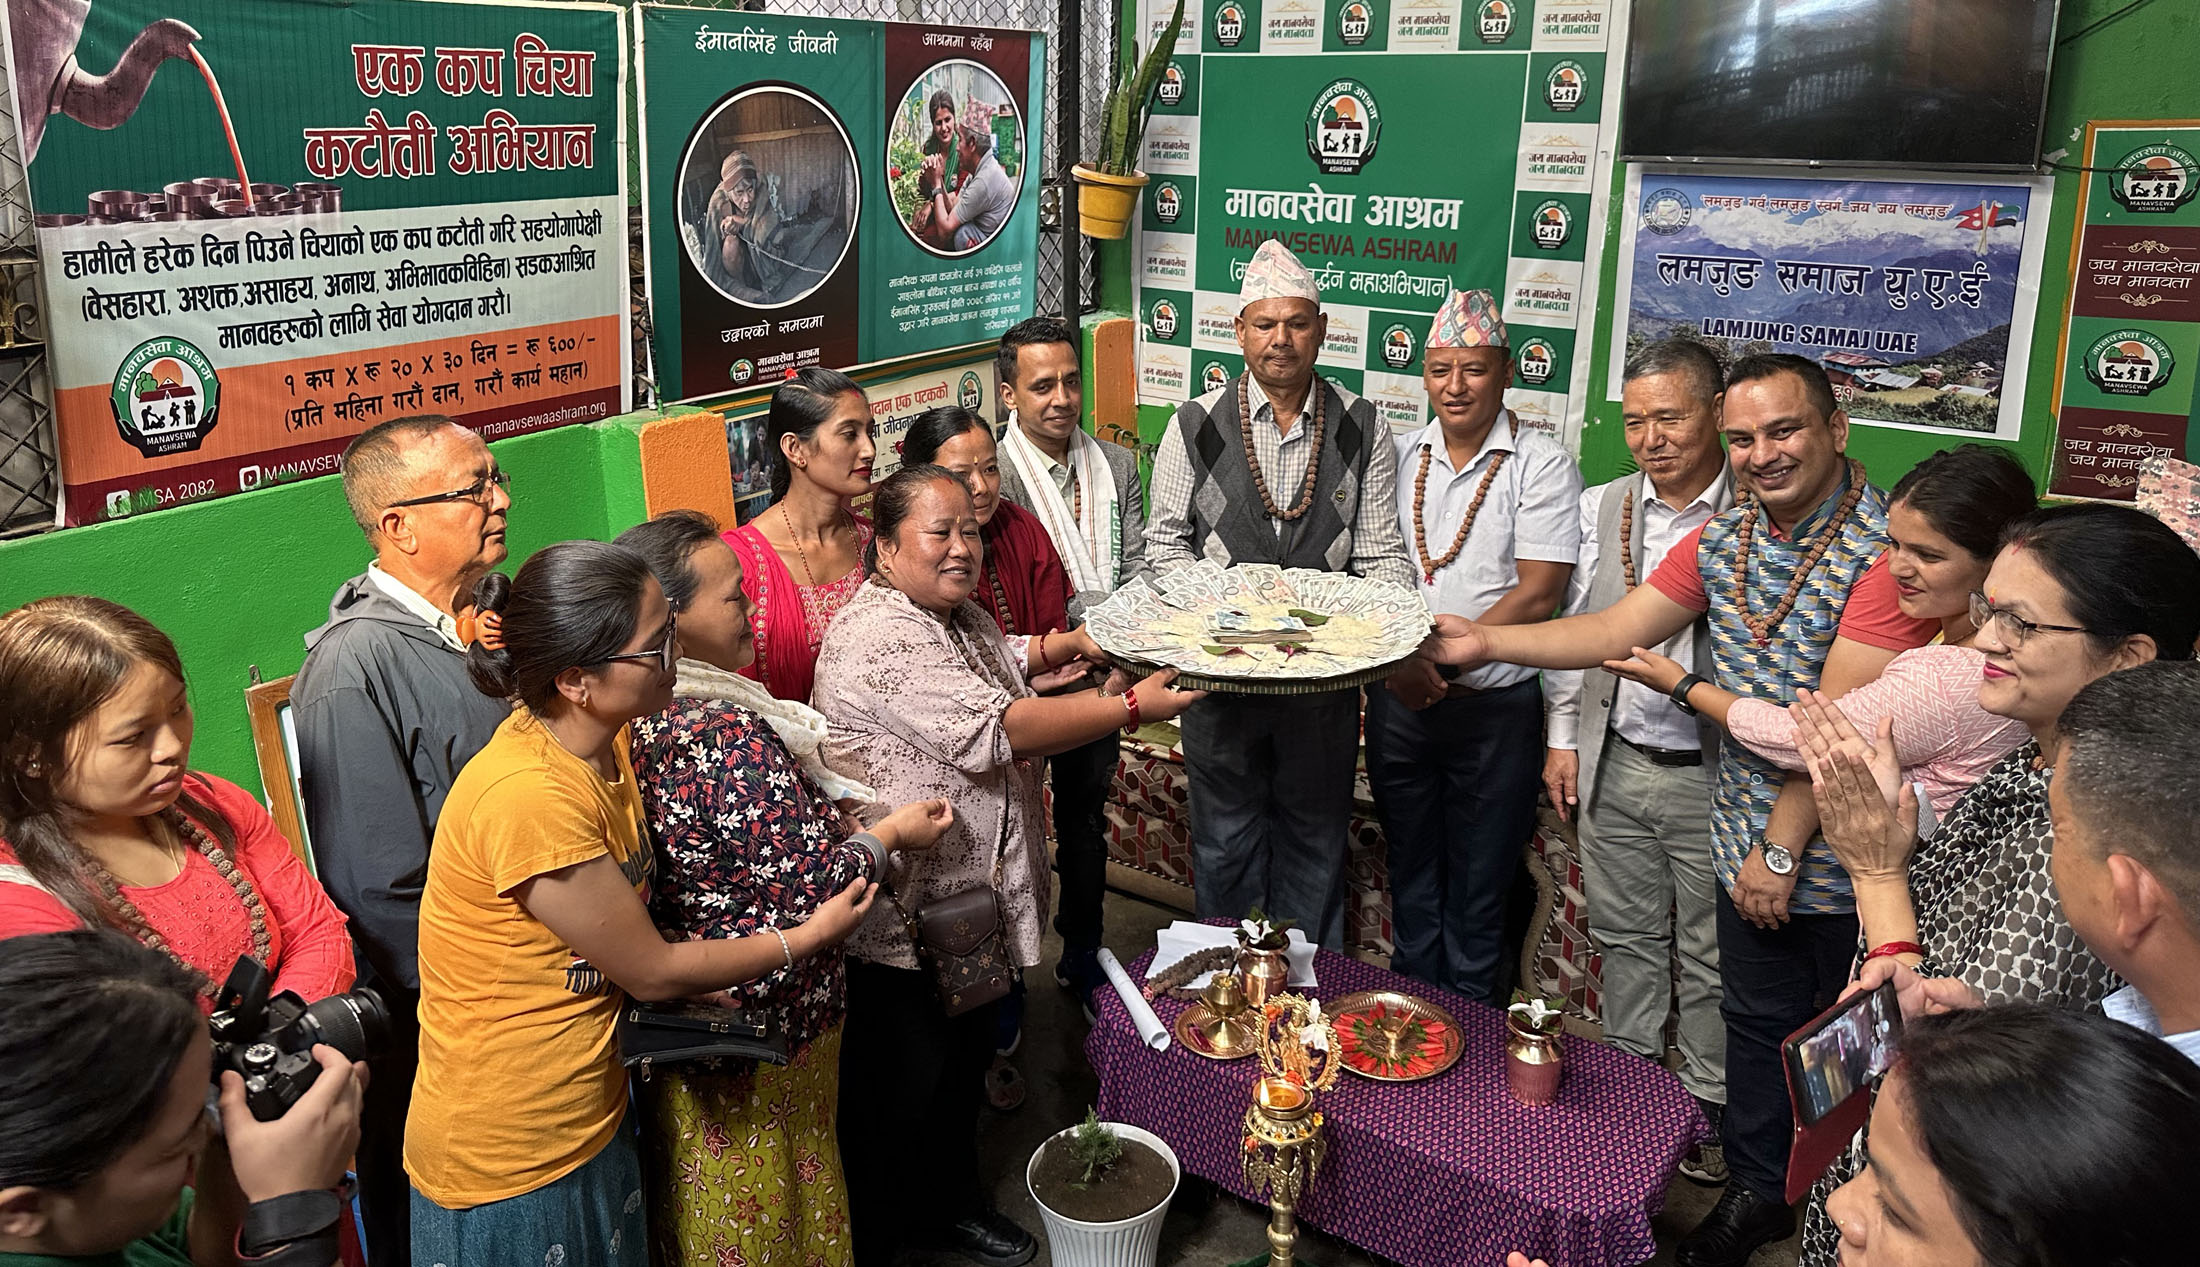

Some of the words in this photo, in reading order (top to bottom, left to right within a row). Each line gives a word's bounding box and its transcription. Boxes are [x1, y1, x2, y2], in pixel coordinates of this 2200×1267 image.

[694, 25, 777, 55] ईमानसिंह
[788, 29, 840, 56] जीवनी
[922, 32, 965, 49] आश्रममा
[351, 42, 425, 98] एक
[435, 46, 503, 98] कप
[514, 32, 595, 98] चिया
[1311, 82, 1353, 120] मानवसेवा
[304, 110, 436, 180] कटौती
[448, 108, 595, 174] अभियान
[1322, 158, 1360, 166] MANAVSEWA
[1225, 183, 1357, 224] मानवसेवा
[1364, 195, 1464, 230] आश्रम
[1876, 201, 1899, 215] जय
[62, 239, 137, 279] हामीले
[143, 237, 195, 273] हरेक
[201, 233, 240, 267] दिन
[246, 230, 295, 263] पिउने
[300, 225, 364, 259] चियाको
[370, 230, 398, 254] एक
[403, 227, 432, 250] कप
[437, 217, 485, 247] कटौती
[490, 214, 517, 244] गरि
[521, 209, 602, 242] सहयोगापेक्षी
[1362, 237, 1457, 264] ASHRAM
[323, 270, 379, 298] अनाथ,
[515, 244, 597, 279] सडकआश्रित
[1656, 253, 1765, 297] लमजुङ
[1775, 259, 1873, 297] समाज
[2088, 258, 2118, 272] जय
[2122, 256, 2200, 274] मानवसेवा
[1349, 270, 1453, 298] महाअभियान)
[2093, 273, 2122, 286] जय
[2127, 274, 2193, 289] मानवता
[329, 303, 371, 337] लागि
[376, 301, 407, 331] सेवा
[412, 297, 474, 326] योगदान
[778, 315, 825, 334] समयमा
[1701, 317, 1797, 344] LAMJUNG
[1799, 324, 1872, 350] SAMAJ
[1873, 331, 1919, 355] UAE
[118, 341, 172, 392] मानवसेवा
[175, 344, 214, 381] आश्रम
[284, 373, 295, 397] १
[305, 369, 334, 392] कप
[390, 358, 413, 377] २०
[442, 351, 463, 370] ३०
[471, 340, 498, 366] दिन
[757, 351, 794, 367] मानवसेवा
[796, 347, 820, 361] आश्रम
[758, 361, 796, 374] MANAVSEWA
[796, 357, 820, 368] ASHRAM
[284, 399, 324, 433] (प्रति
[333, 391, 383, 421] महिना
[432, 381, 465, 406] दान,
[512, 363, 542, 389] कार्य
[548, 358, 588, 384] महान)
[895, 394, 912, 411] एक
[914, 381, 949, 405] पटकको
[2104, 382, 2148, 391] MANAVSEWA
[146, 430, 197, 446] MANAVSEWA
[158, 441, 188, 453] ASHRAM
[2064, 438, 2092, 452] जय
[2096, 441, 2175, 459] मानवसेवा
[264, 452, 344, 482] MANAVSEW
[2069, 454, 2097, 467] जय
[179, 478, 216, 500] 2082
